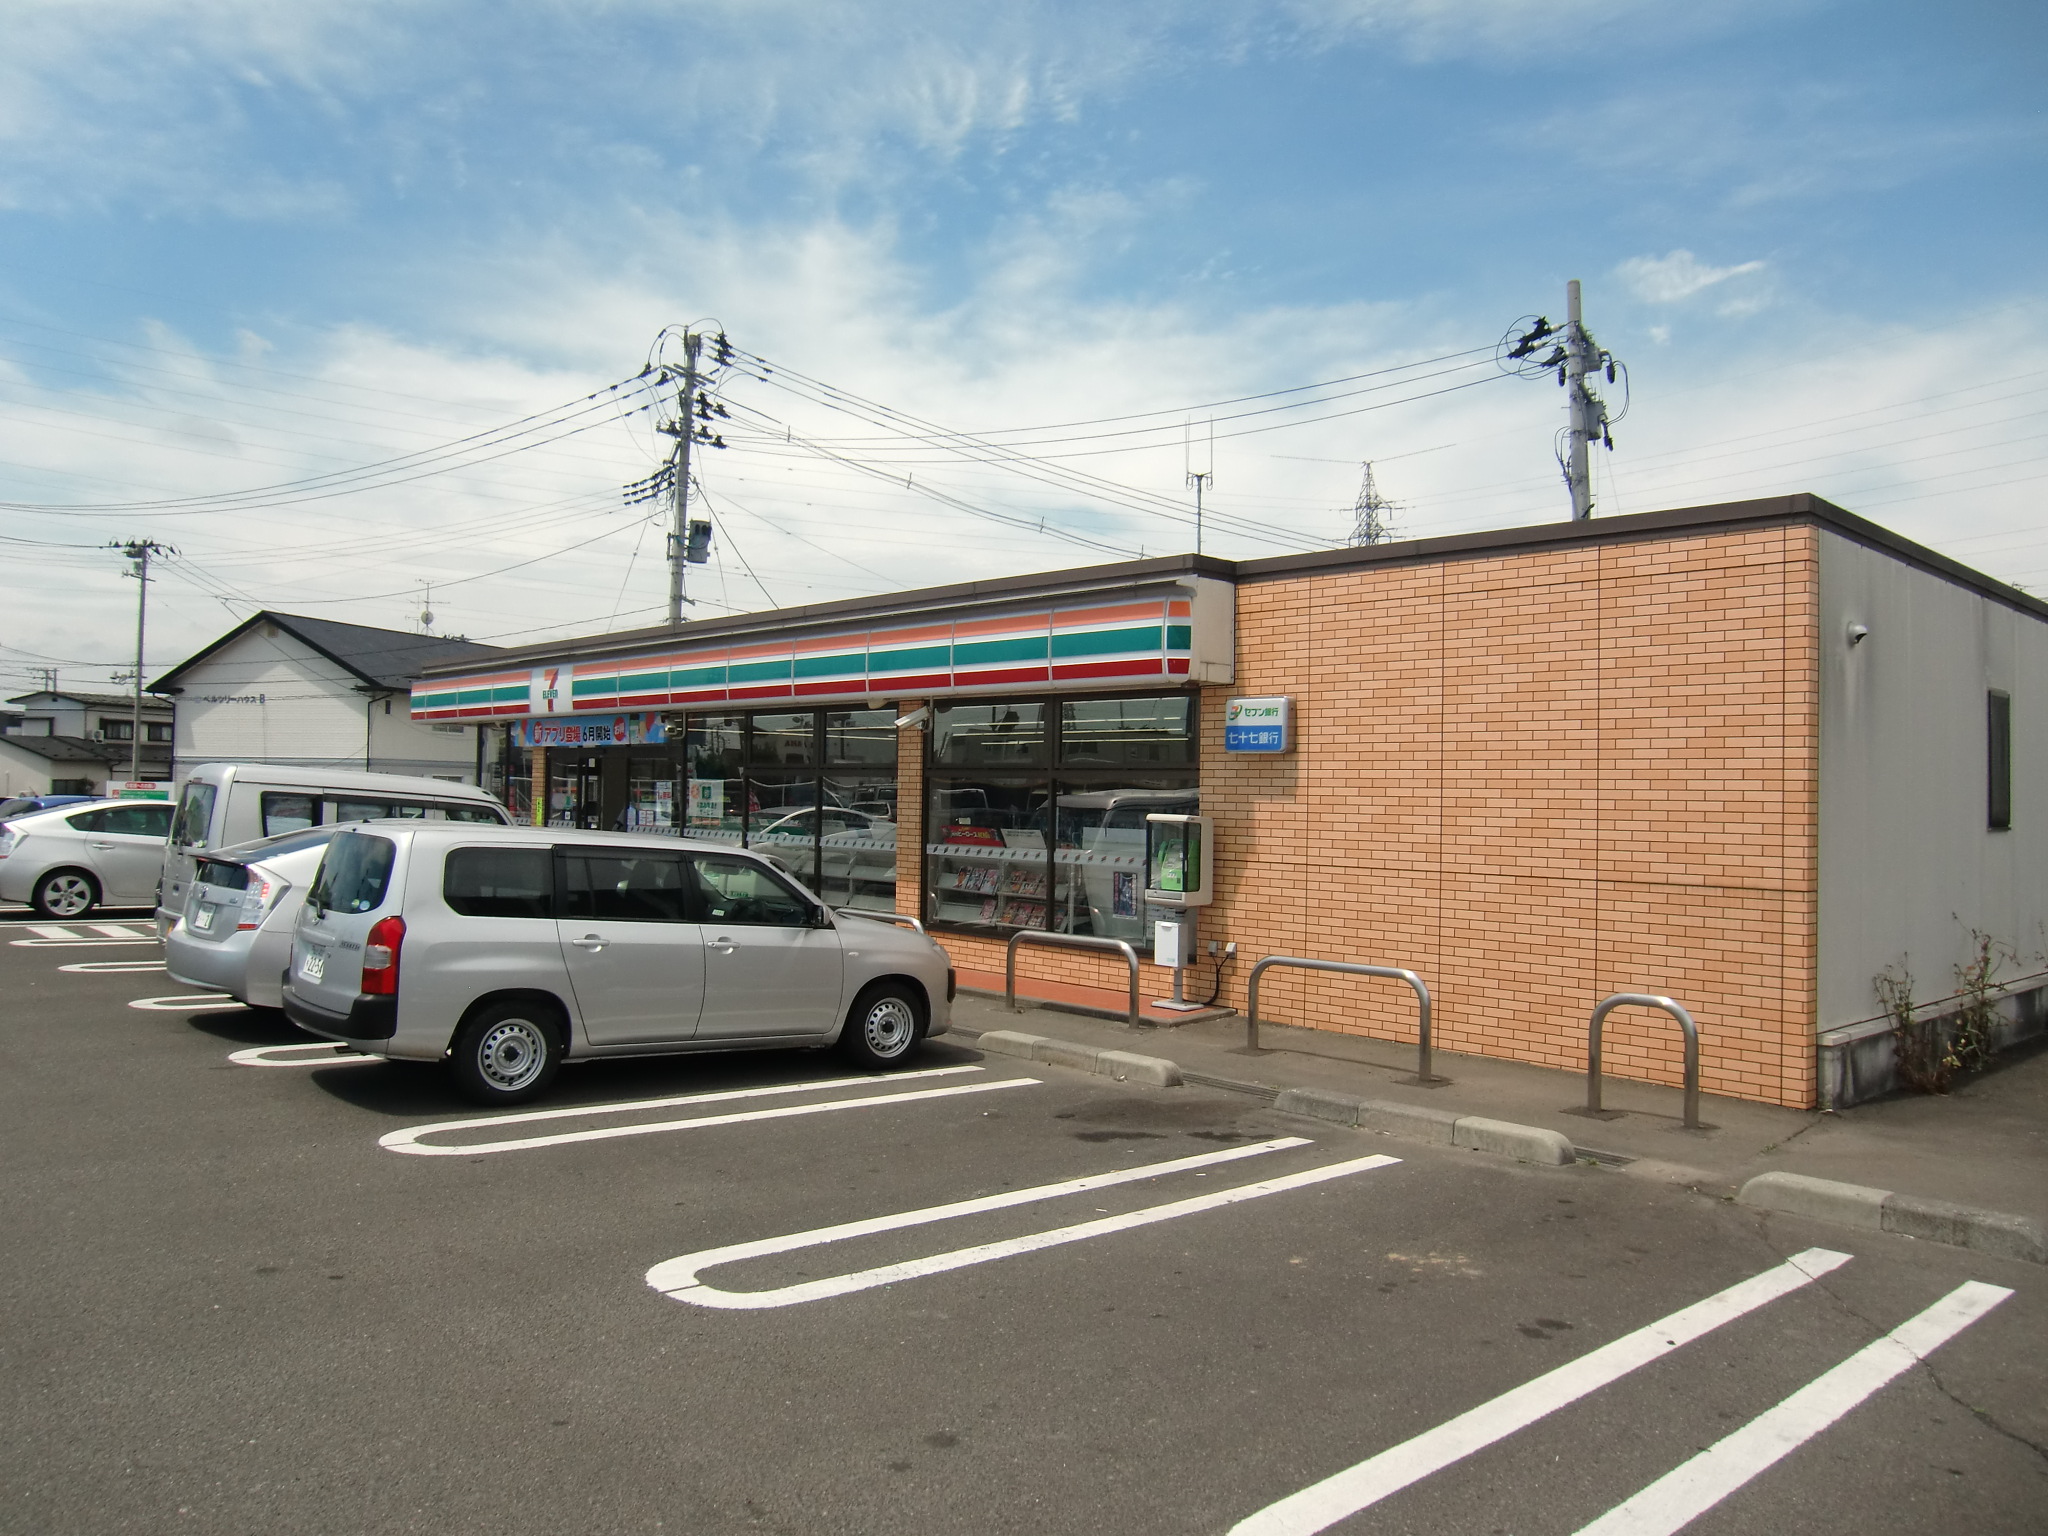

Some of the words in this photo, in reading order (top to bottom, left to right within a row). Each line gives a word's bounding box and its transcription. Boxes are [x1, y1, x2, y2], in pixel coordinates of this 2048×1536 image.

[260, 693, 266, 704] B
[1244, 707, 1279, 717] セブン銀行
[534, 725, 542, 742] 新
[544, 726, 581, 743] アプリ登場
[582, 725, 611, 742] 6月開始
[1228, 731, 1279, 744] 七十七銀行
